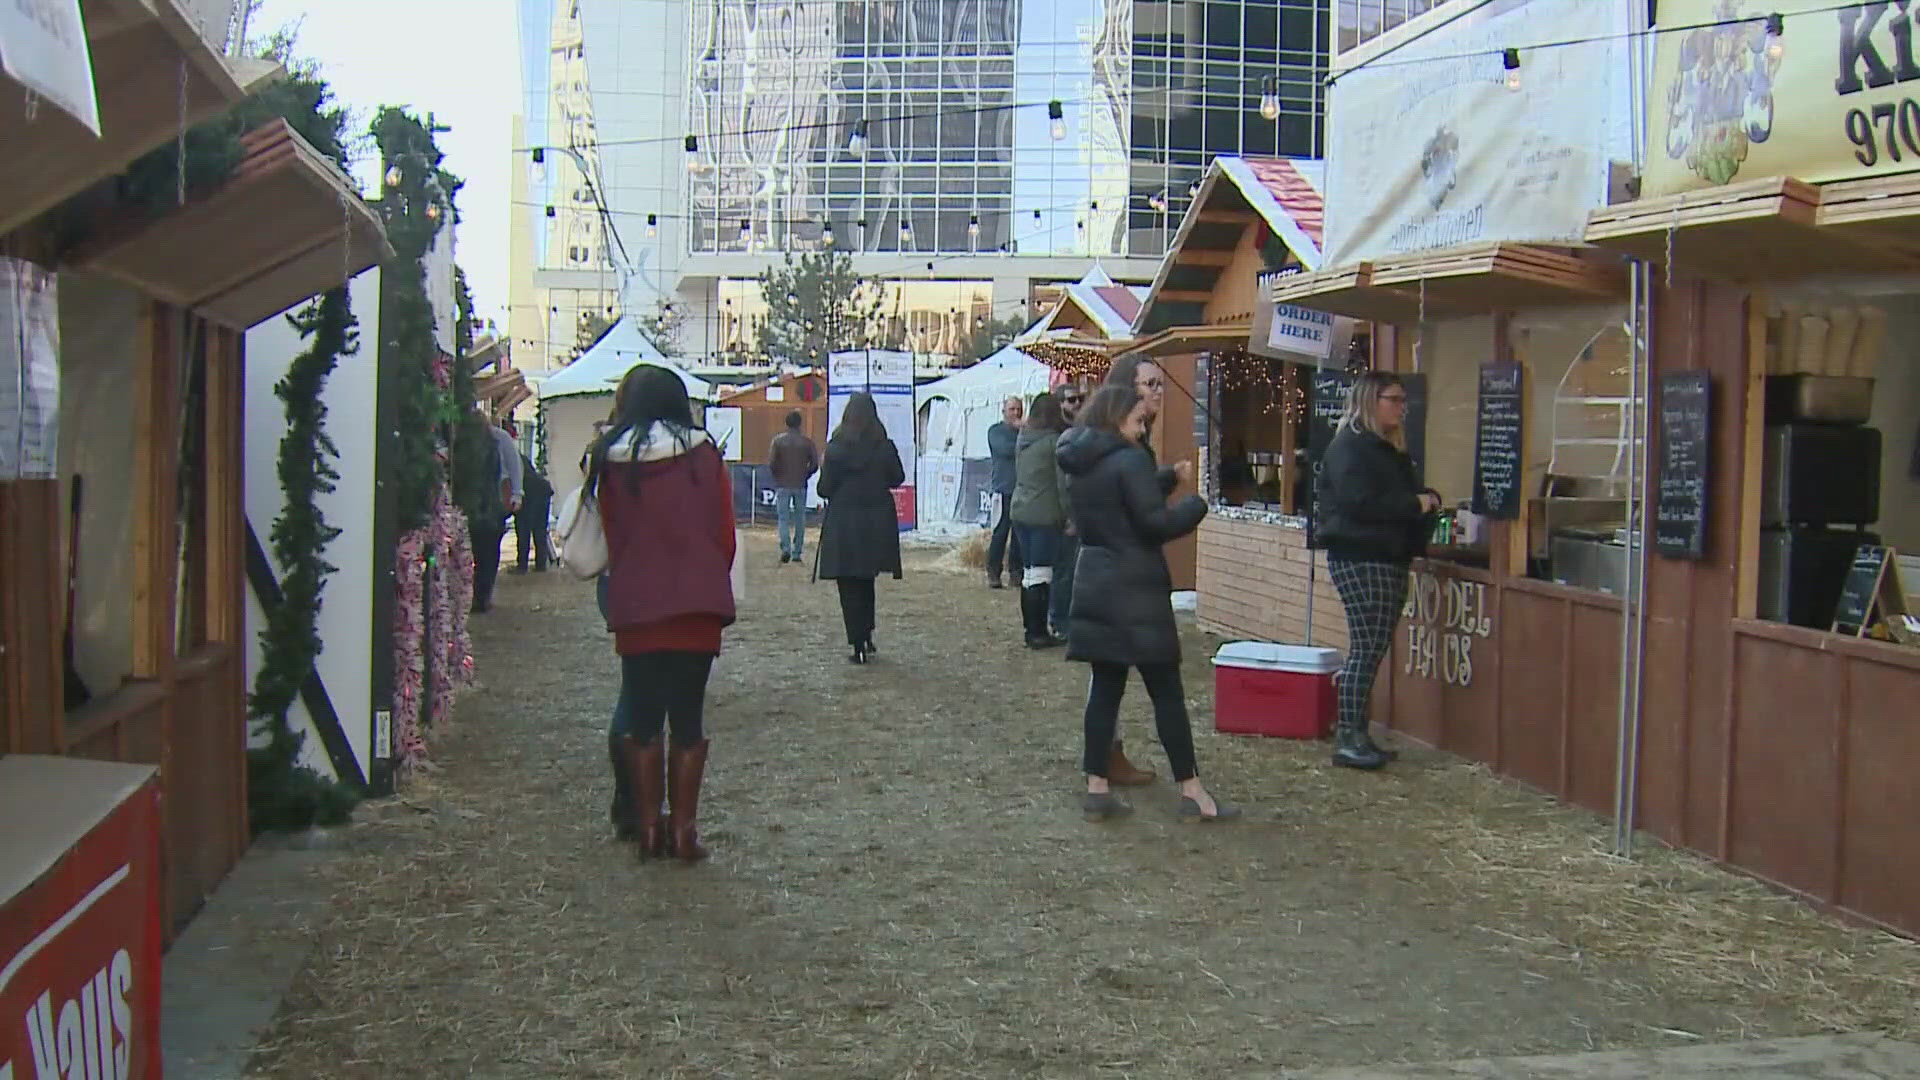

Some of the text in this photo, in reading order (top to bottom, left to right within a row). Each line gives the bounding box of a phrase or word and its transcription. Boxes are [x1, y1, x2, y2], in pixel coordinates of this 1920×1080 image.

[1835, 0, 1920, 95] Ki
[1278, 304, 1331, 326] ORDER
[1280, 323, 1323, 342] HERE
